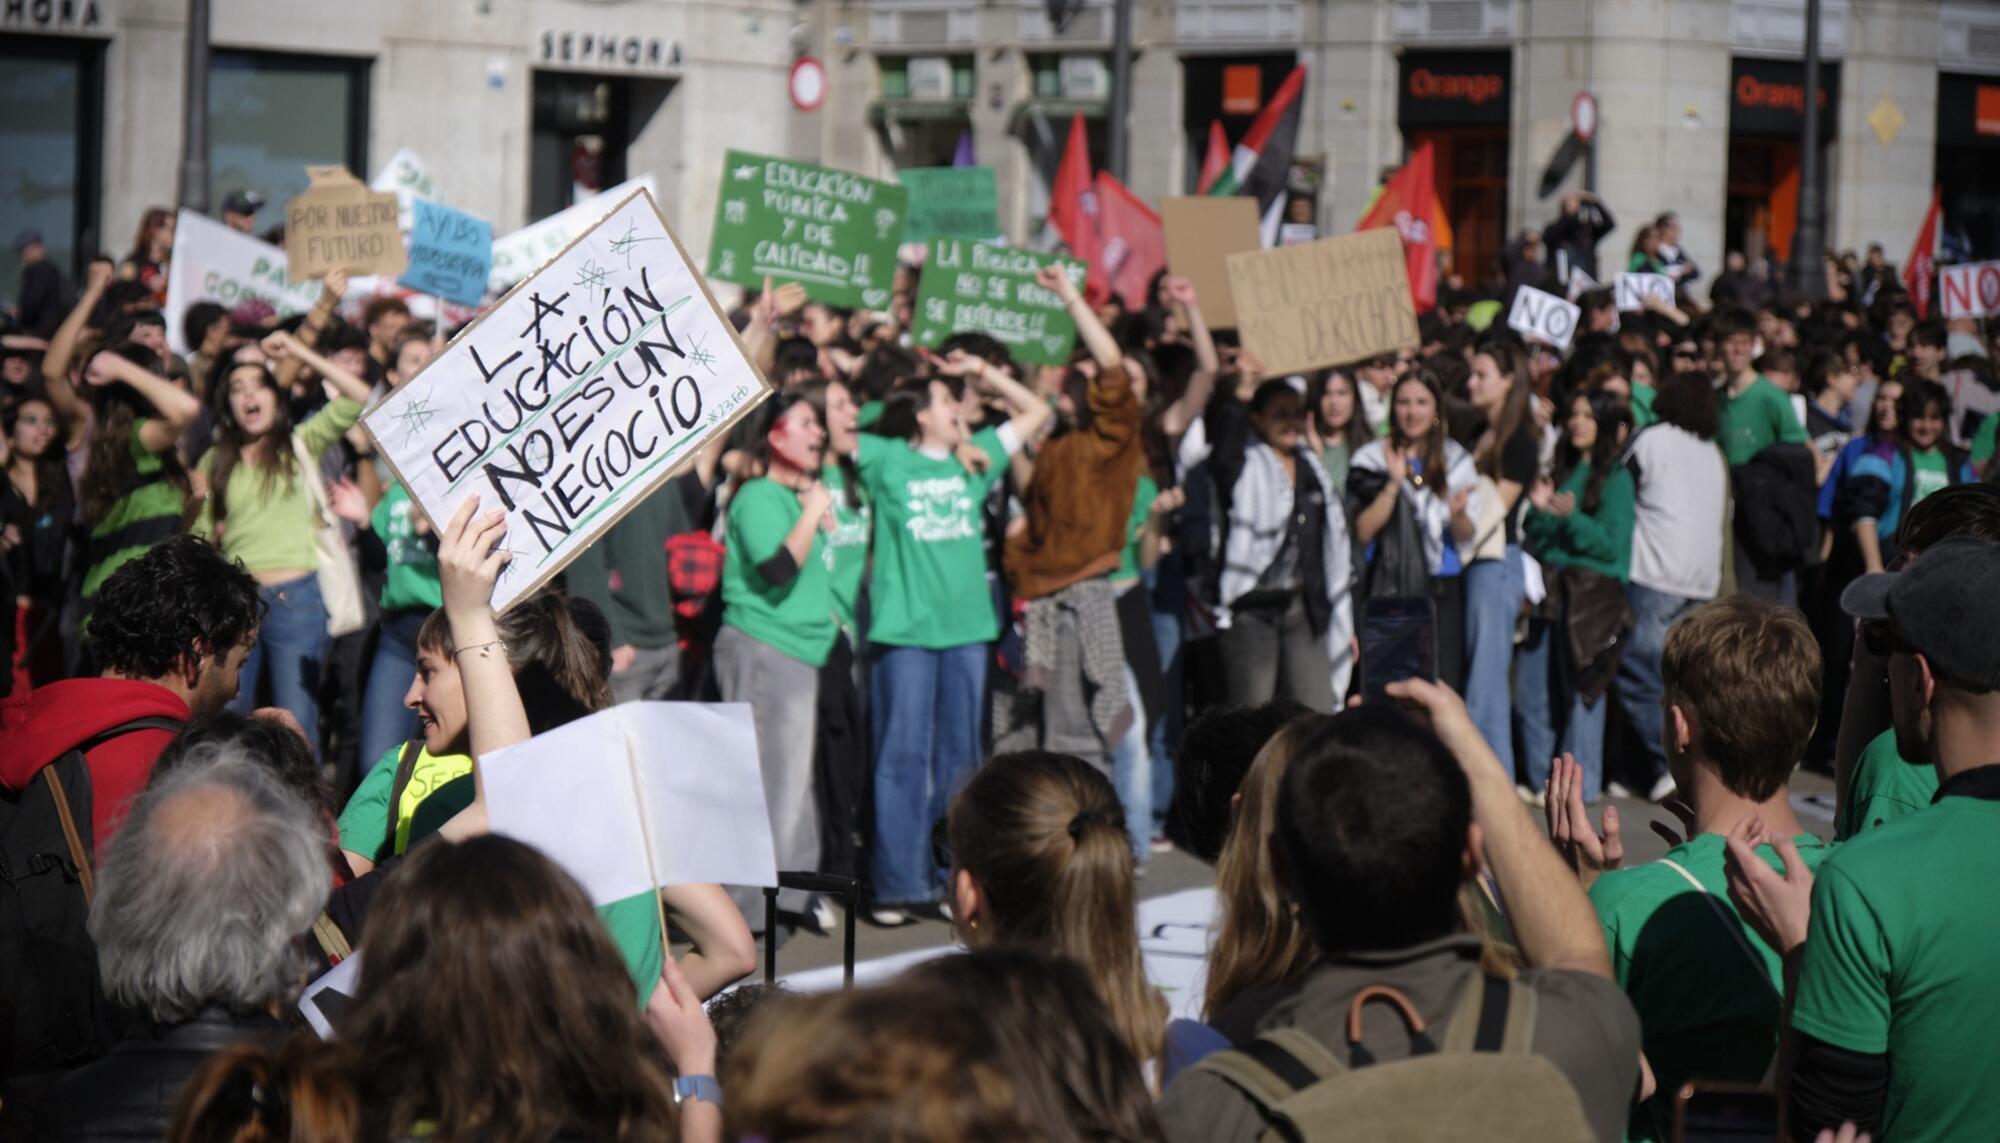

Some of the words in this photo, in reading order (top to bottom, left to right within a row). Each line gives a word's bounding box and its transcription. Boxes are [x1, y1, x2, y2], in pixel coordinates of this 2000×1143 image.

[539, 30, 685, 65] SEPHORA
[1408, 68, 1504, 105] Orange
[764, 161, 875, 204] EDUCACIÓN
[291, 204, 327, 232] POR
[335, 199, 398, 229] NUESTRO
[782, 217, 797, 239] Y
[803, 223, 835, 247] DE
[935, 239, 960, 269] LA
[954, 272, 984, 296] NO
[986, 275, 1009, 300] SE
[1620, 277, 1670, 310] NO
[1943, 262, 2000, 316] NO
[924, 297, 948, 324] SE
[1517, 294, 1571, 338] NO
[470, 292, 570, 383] LA
[432, 267, 664, 482] EDUCACIÓN
[482, 429, 554, 512] NO
[551, 377, 616, 453] ES
[615, 314, 686, 390] UN
[522, 375, 702, 552] NEGOCIO
